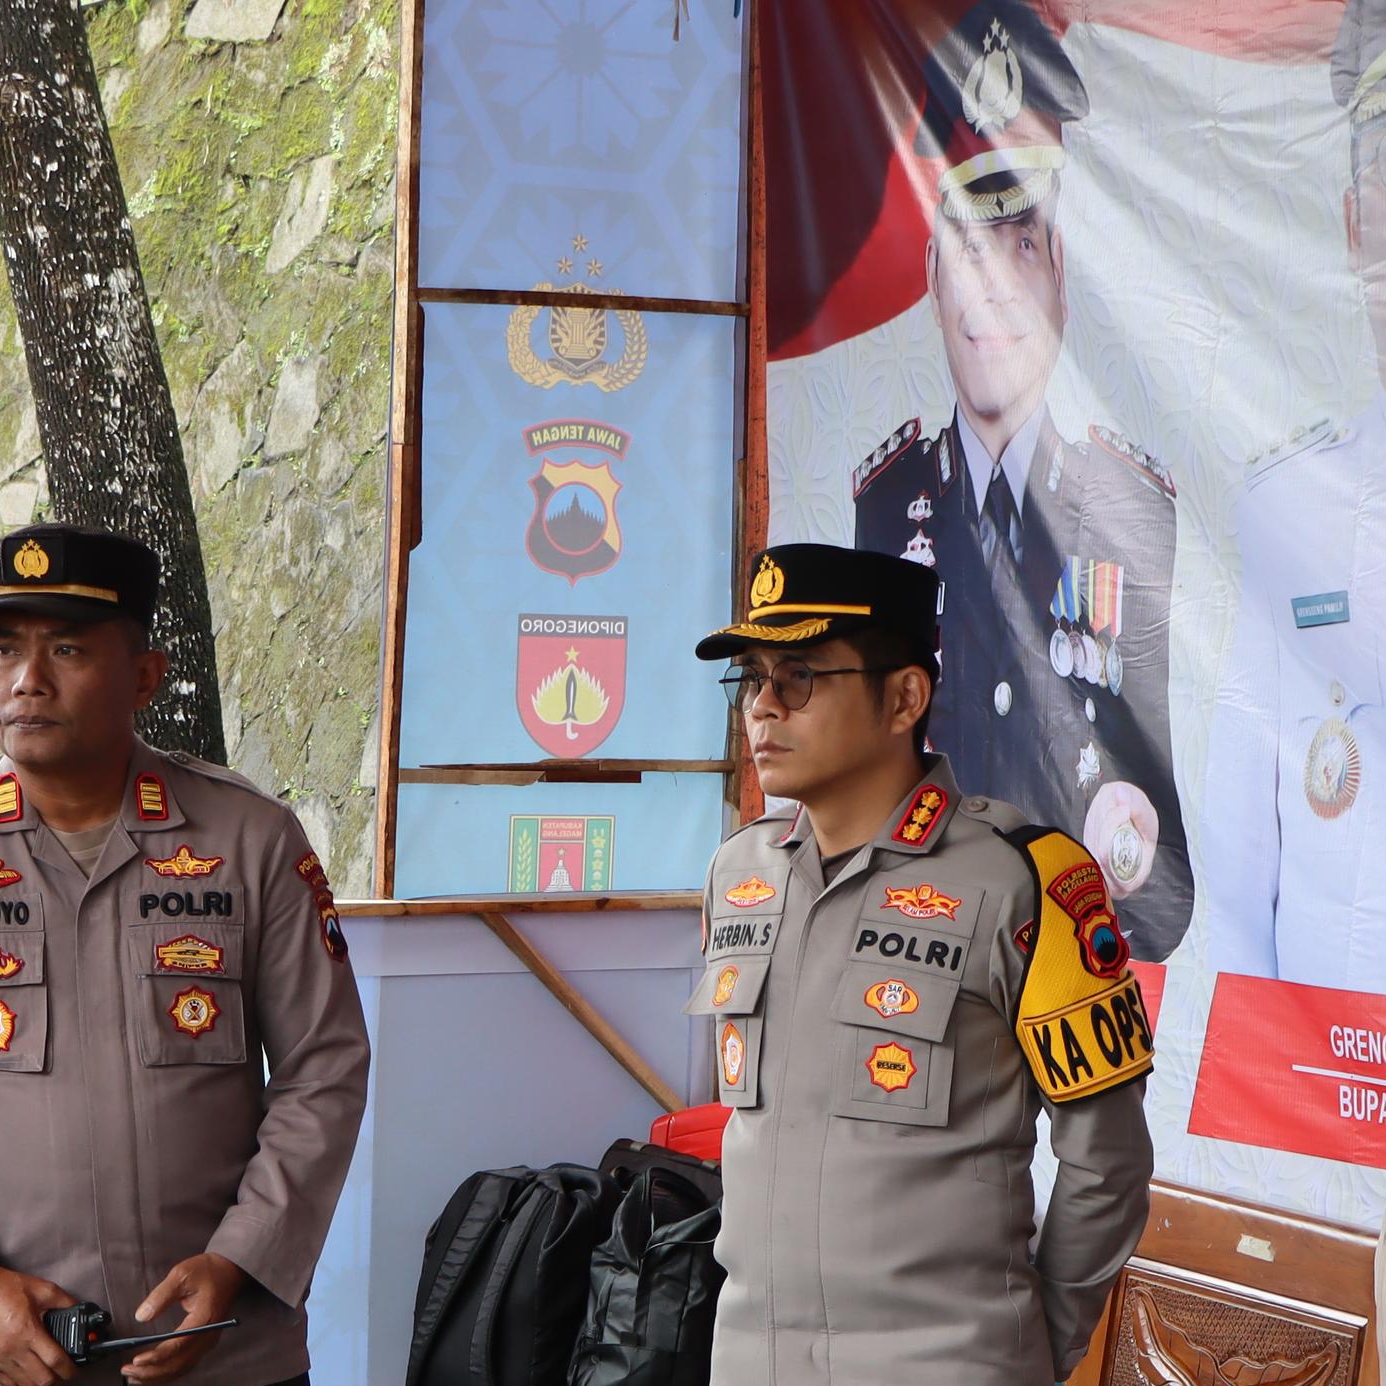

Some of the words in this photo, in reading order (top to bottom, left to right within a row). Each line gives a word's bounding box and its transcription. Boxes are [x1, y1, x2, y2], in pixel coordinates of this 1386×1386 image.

[1056, 866, 1099, 895] POLRESTA
[139, 891, 233, 919] POLRI
[855, 929, 963, 971] POLRI
[1032, 1017, 1094, 1090] KA
[1090, 987, 1153, 1068] OPS
